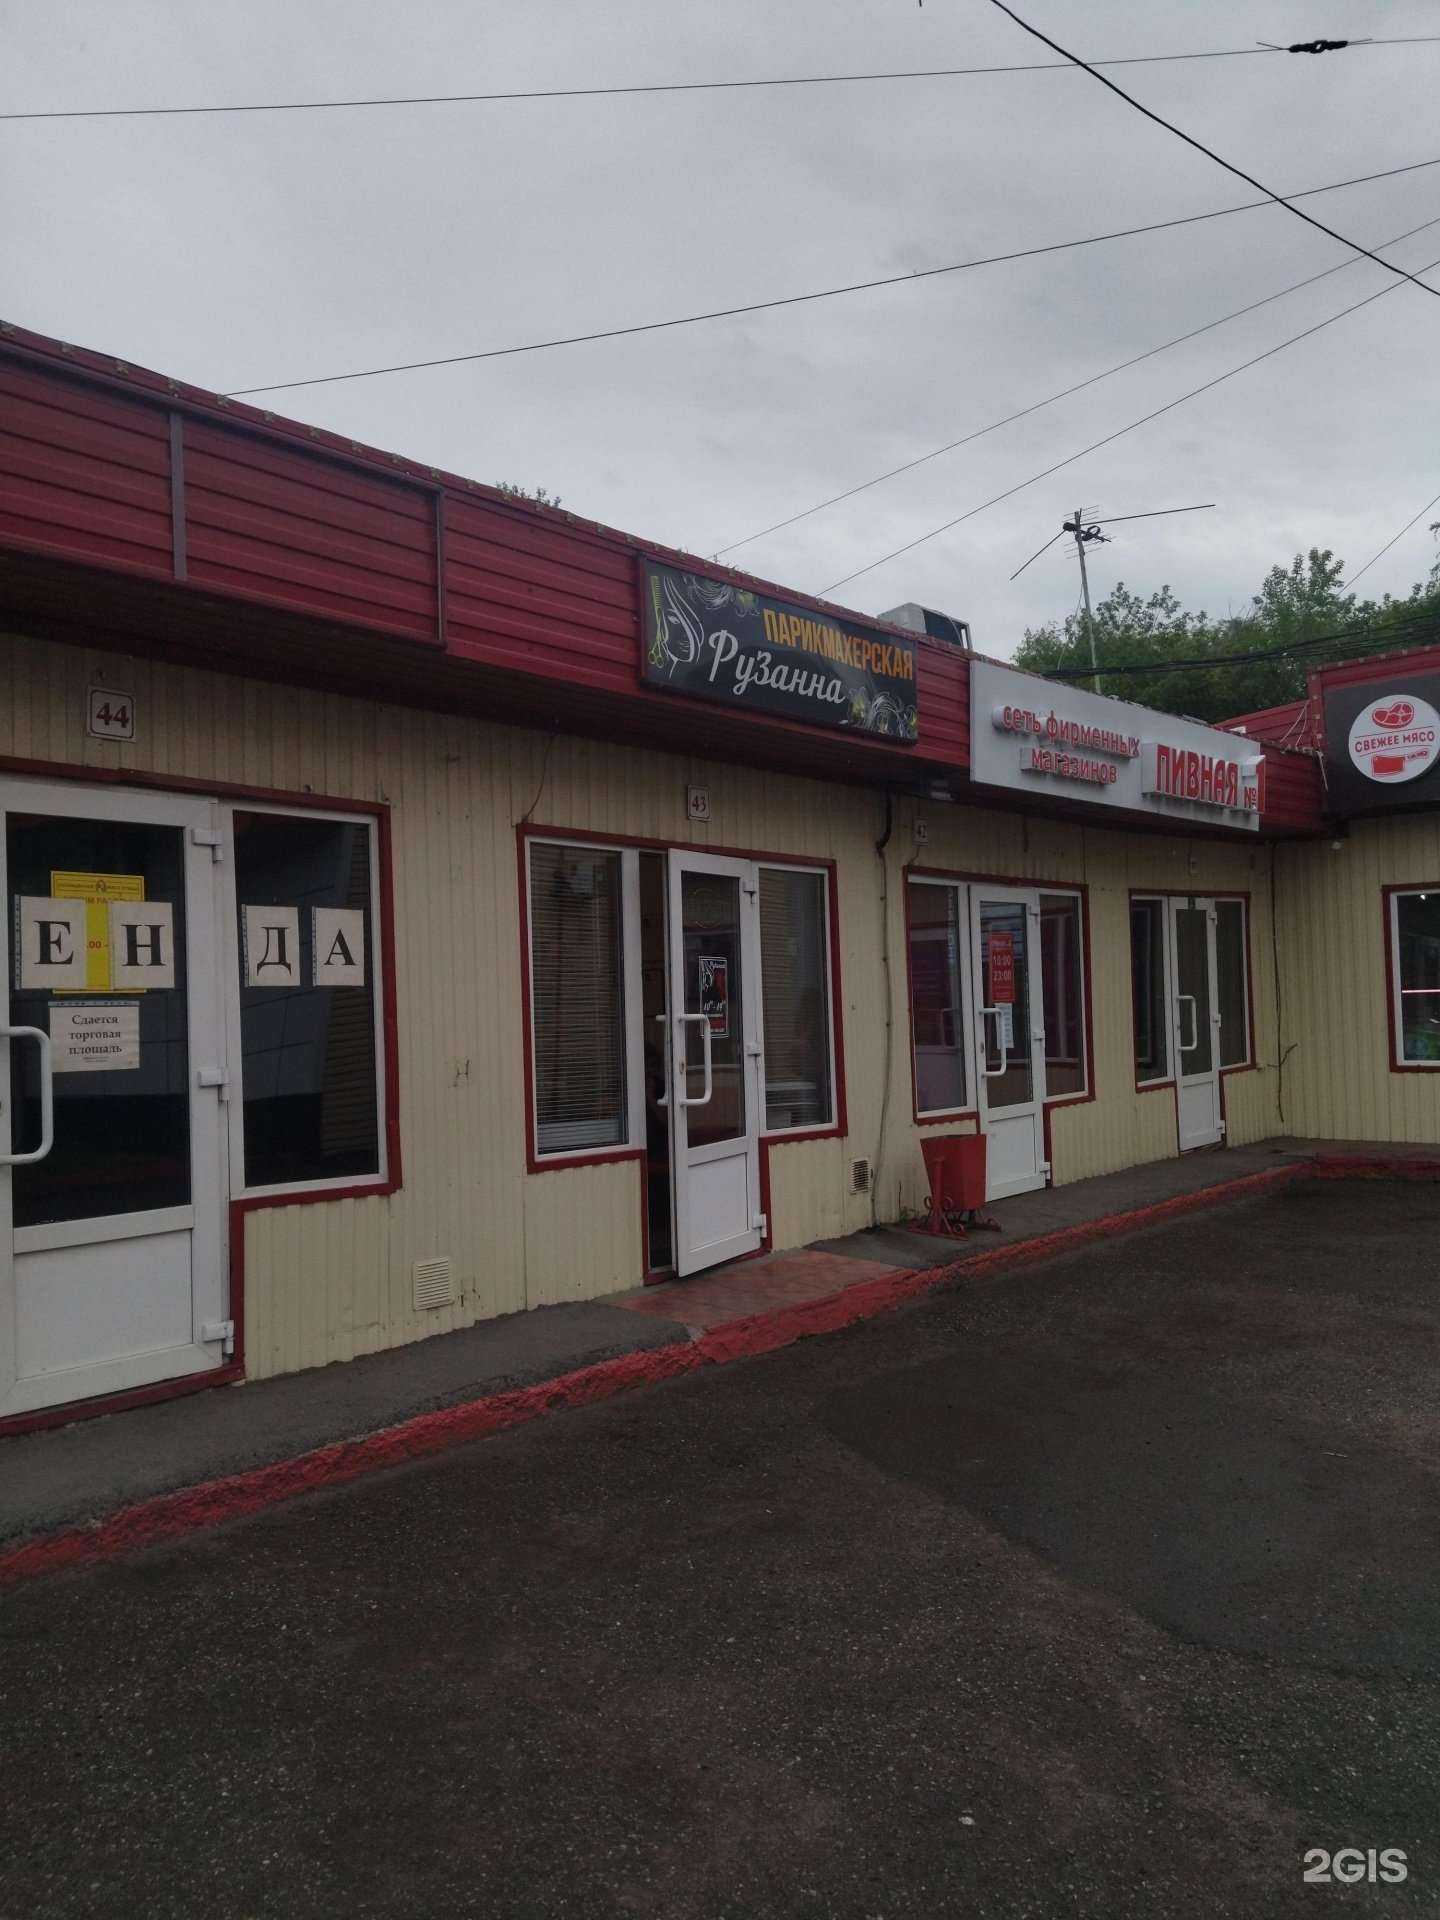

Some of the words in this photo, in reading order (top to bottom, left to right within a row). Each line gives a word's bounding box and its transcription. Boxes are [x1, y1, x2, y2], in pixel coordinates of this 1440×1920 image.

[762, 608, 913, 681] ПАРИКМАХЕРСКАЯ
[708, 629, 847, 704] Рузанна
[96, 702, 130, 728] 44
[1003, 704, 1041, 733] сеть
[1045, 710, 1142, 758] фирменных
[1354, 735, 1400, 753] СВЕЖЕЕ
[1402, 731, 1436, 744] МЯСО
[1032, 747, 1120, 785] магазинов
[1154, 744, 1240, 808] ПИВНАЯ
[692, 795, 706, 812] 43
[72, 1015, 119, 1025] Сдается
[70, 1031, 121, 1042] торговая
